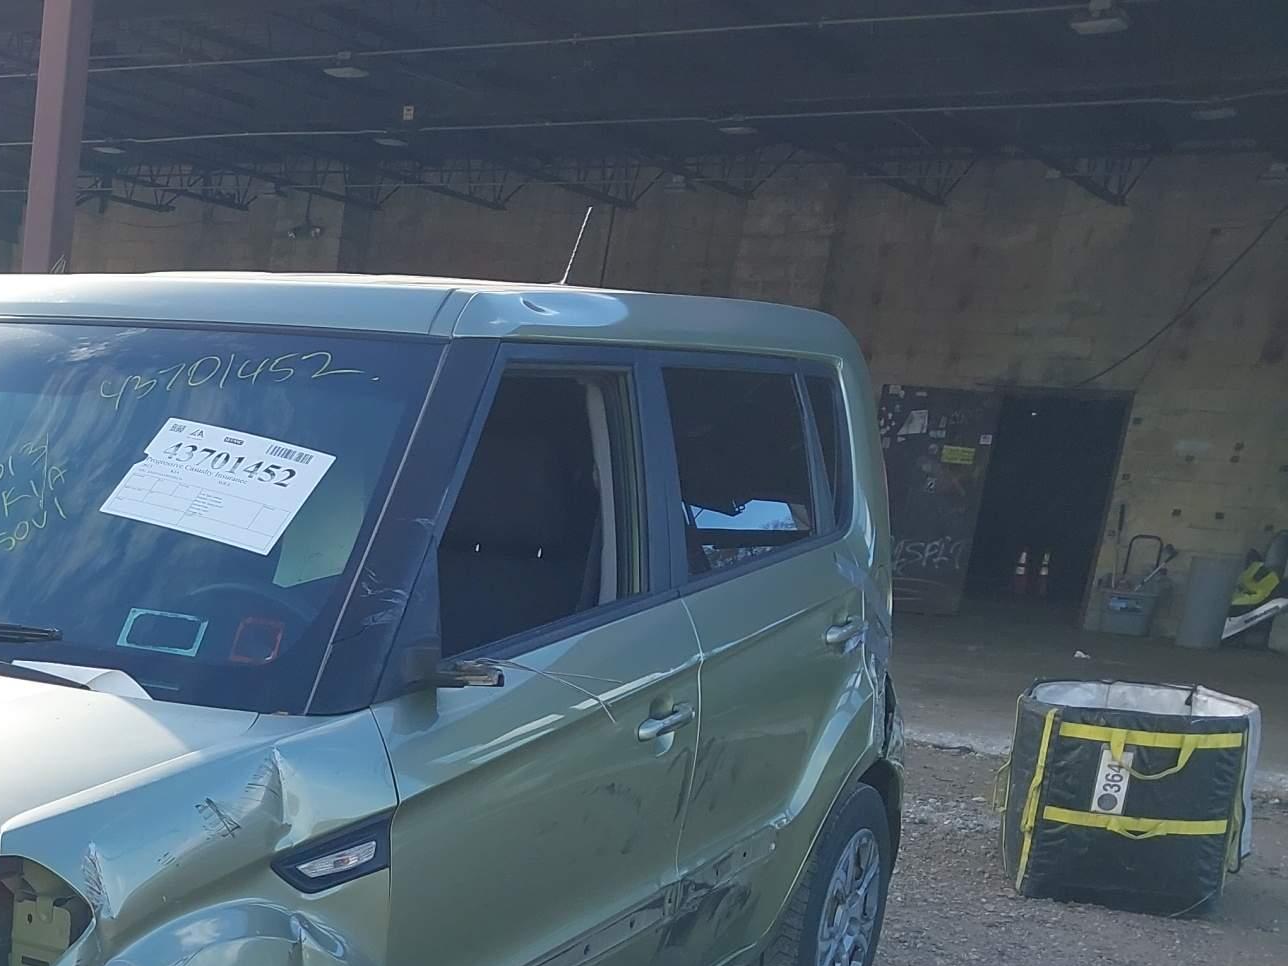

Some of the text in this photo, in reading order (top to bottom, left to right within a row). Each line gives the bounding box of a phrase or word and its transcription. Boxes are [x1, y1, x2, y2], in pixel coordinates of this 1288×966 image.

[162, 442, 297, 489] 43701452
[184, 464, 214, 477] Casualty
[214, 471, 249, 486] Insurance
